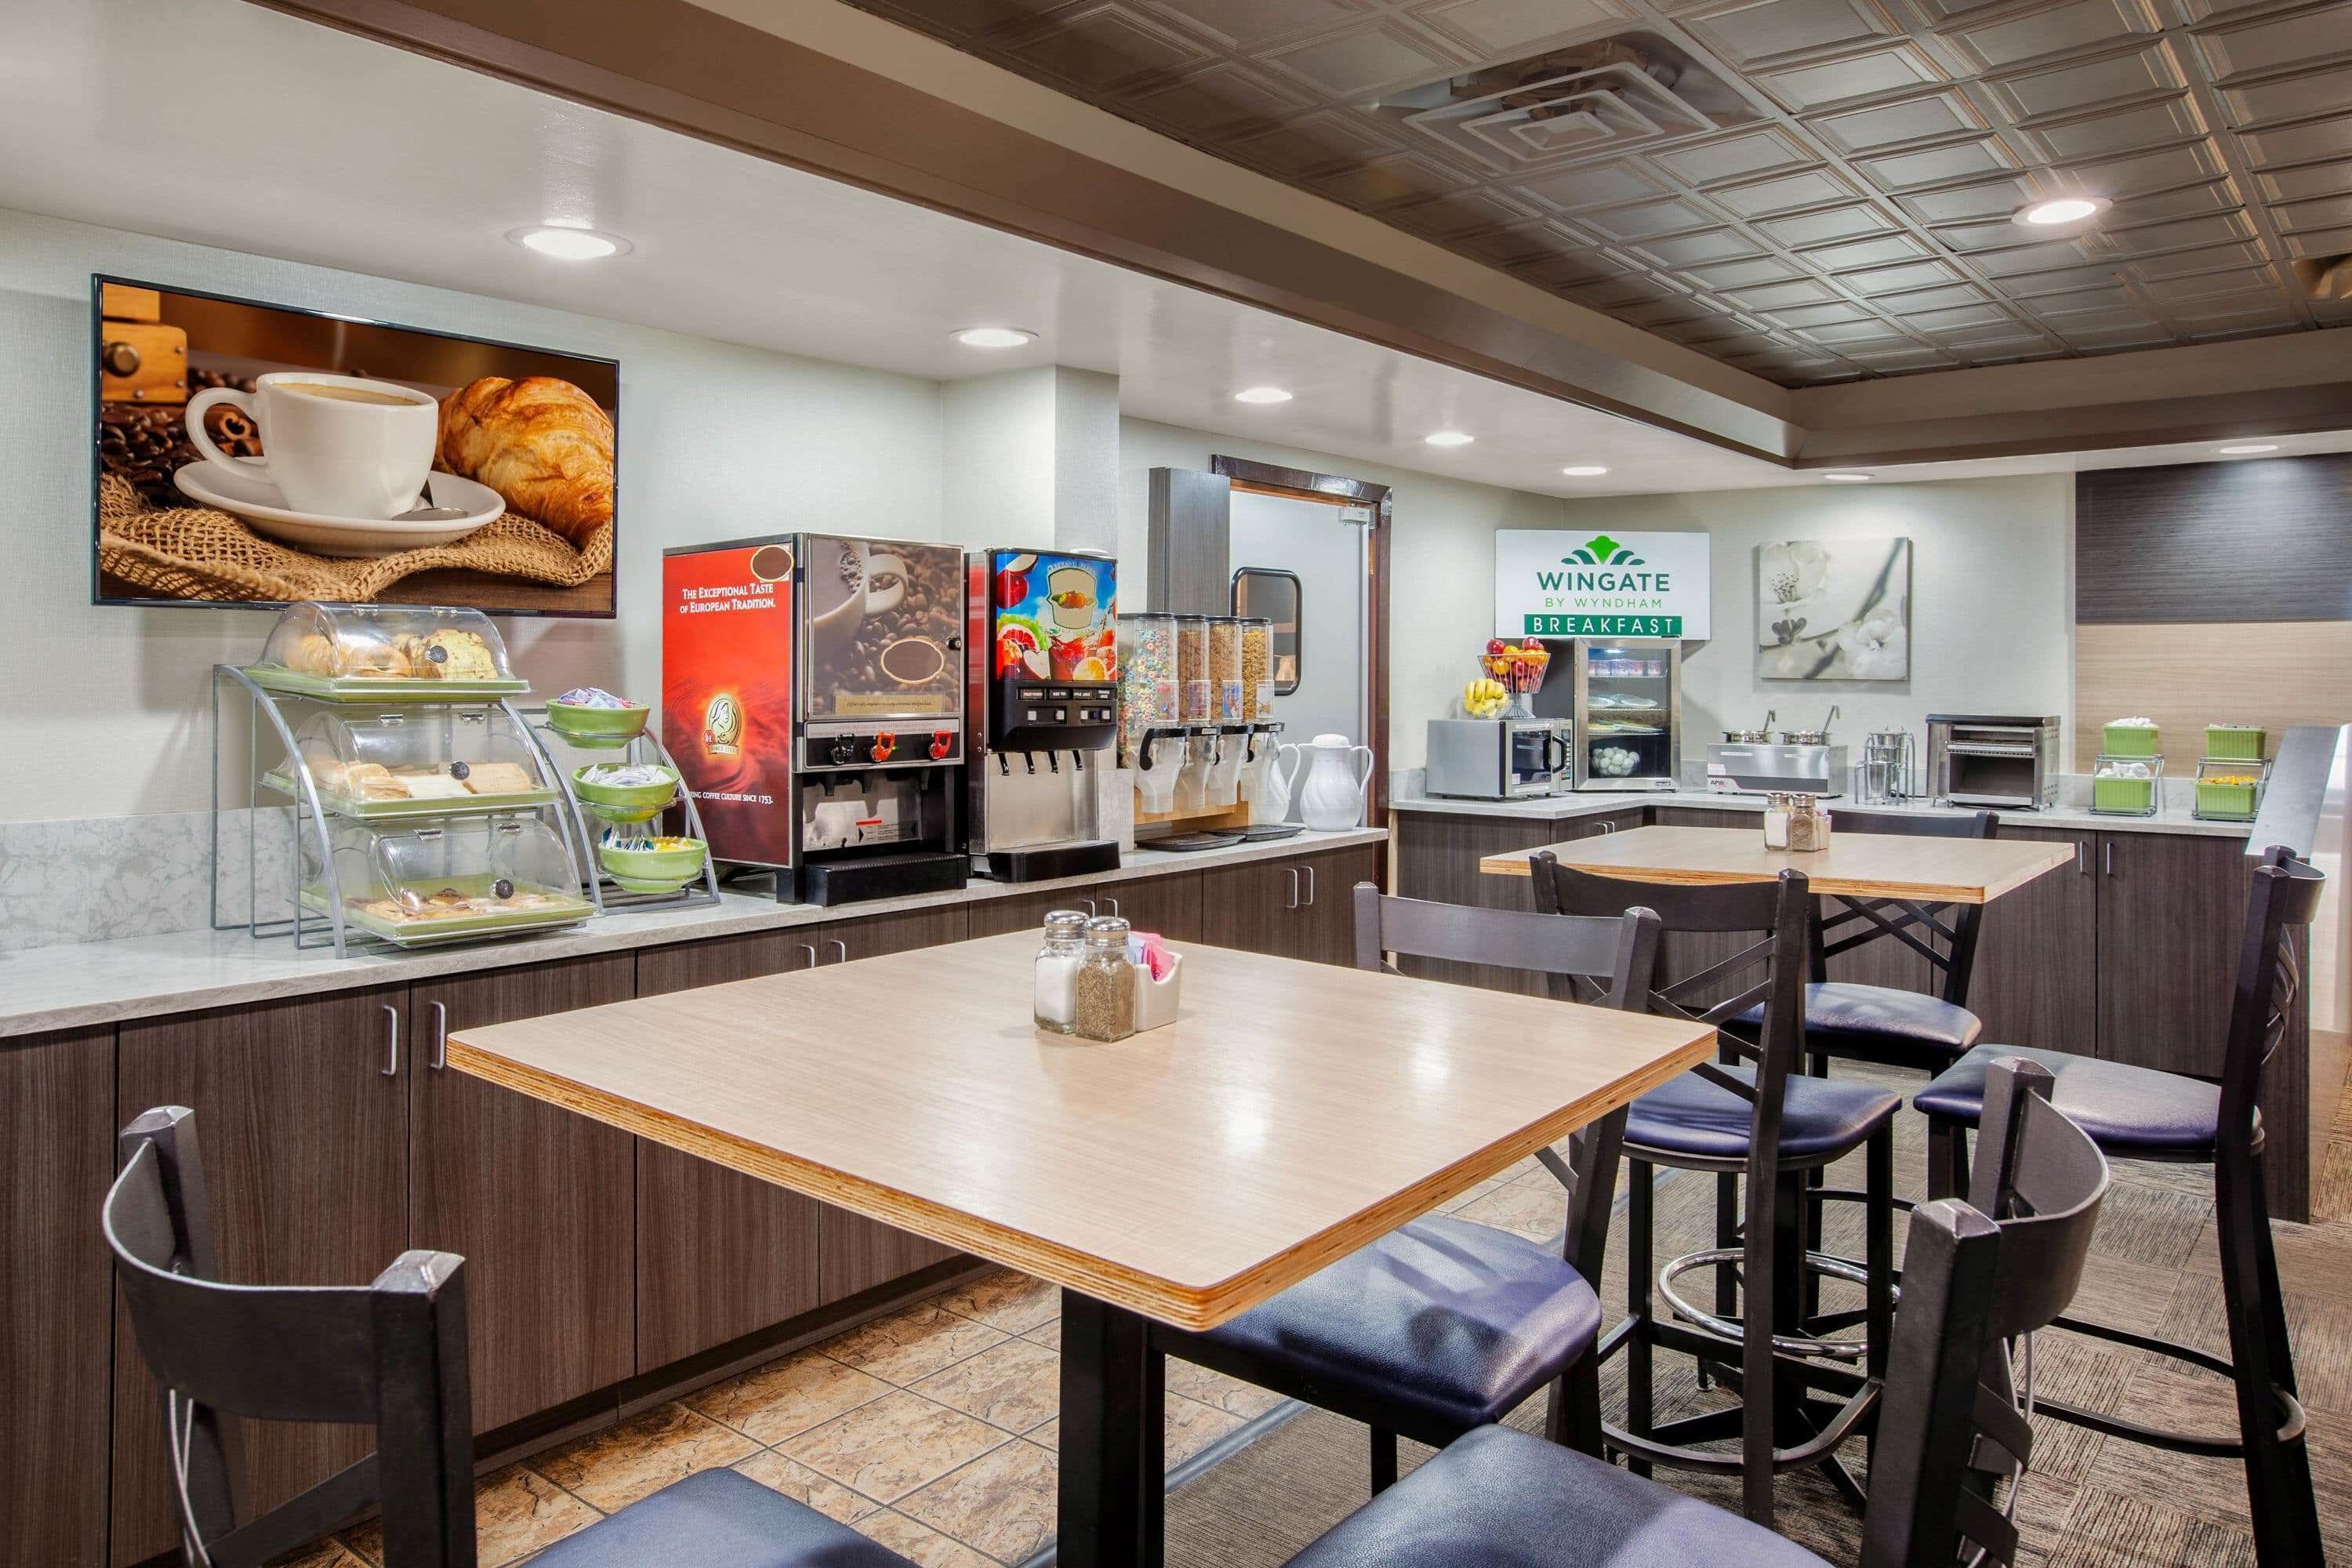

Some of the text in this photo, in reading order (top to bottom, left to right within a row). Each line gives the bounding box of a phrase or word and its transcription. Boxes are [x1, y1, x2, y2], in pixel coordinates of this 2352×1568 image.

[1537, 572, 1670, 591] WINGATE
[682, 583, 774, 600] THE EXCEPTIONAL TASTE
[690, 601, 730, 613] EUROPEAN
[731, 598, 776, 610] TRADITION.
[1545, 597, 1662, 608] BY WYNDHAM
[1534, 618, 1673, 633] BREAKFAST
[721, 793, 742, 801] CULTURE
